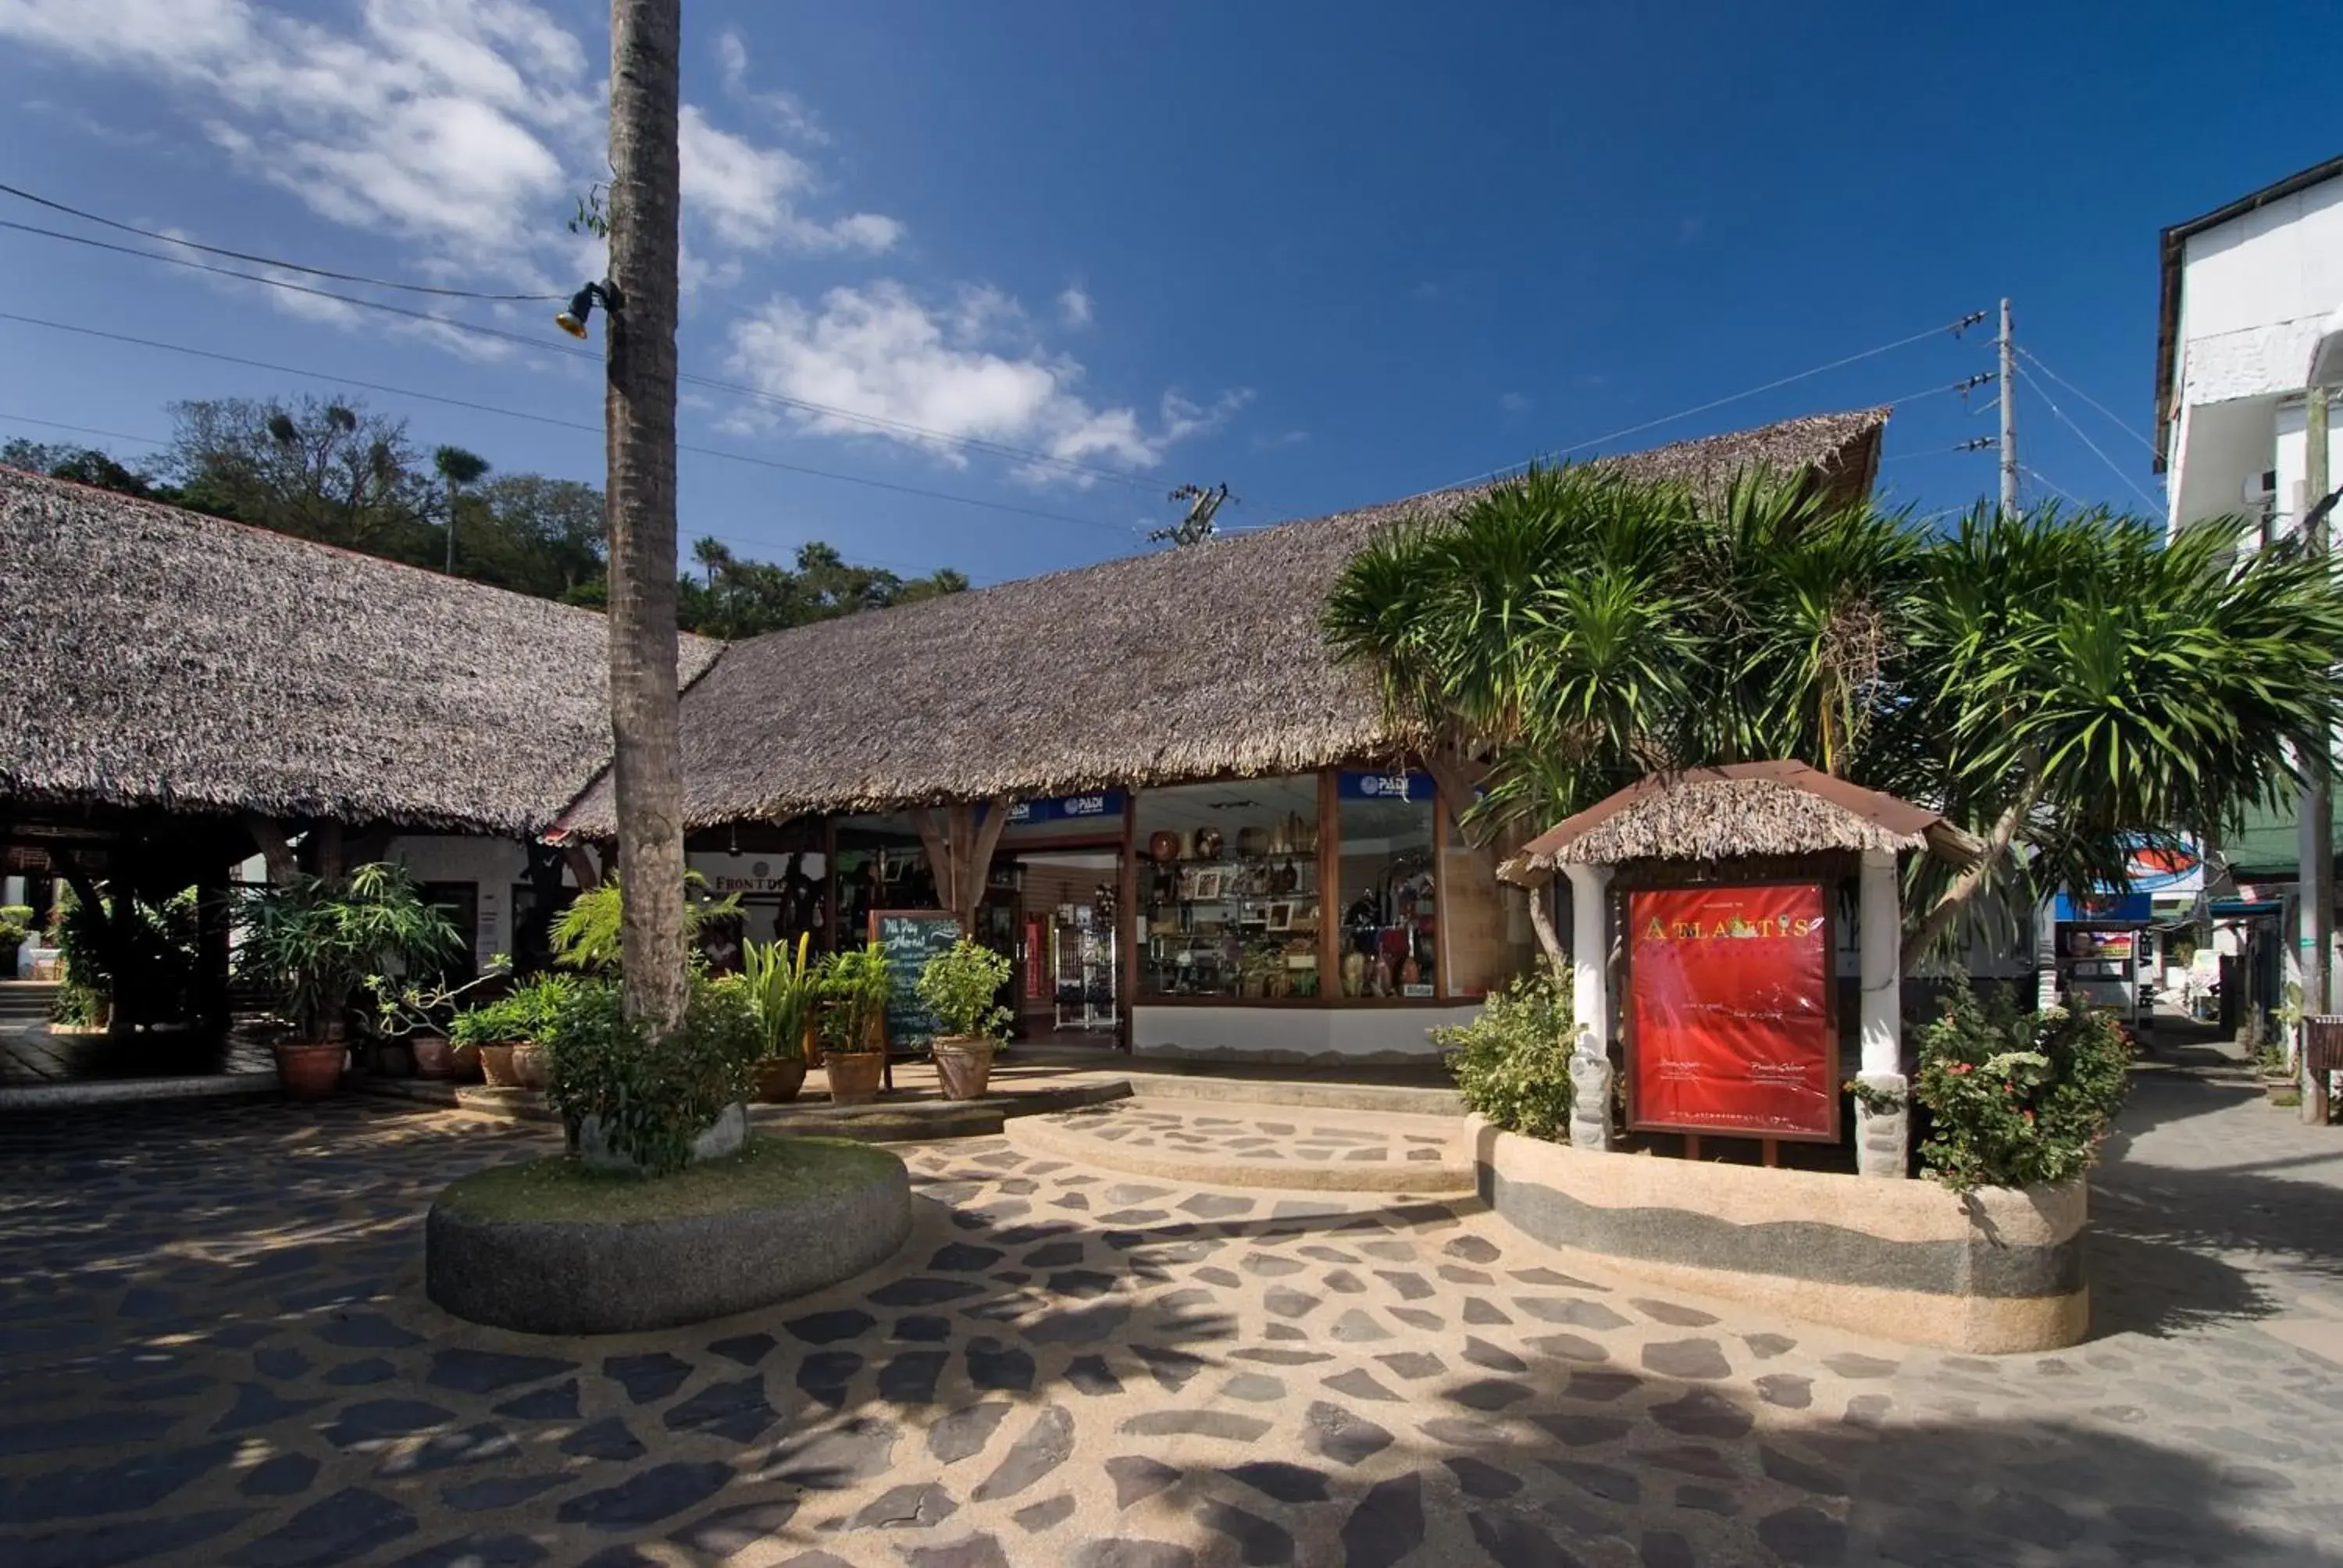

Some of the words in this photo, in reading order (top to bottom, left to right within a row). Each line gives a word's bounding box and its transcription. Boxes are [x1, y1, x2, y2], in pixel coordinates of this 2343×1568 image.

[1378, 777, 1409, 789] PADI
[1079, 796, 1104, 808] PADI
[1011, 803, 1030, 815] ADI
[716, 875, 763, 889] FRONT
[1645, 914, 1809, 939] ATLANTIS
